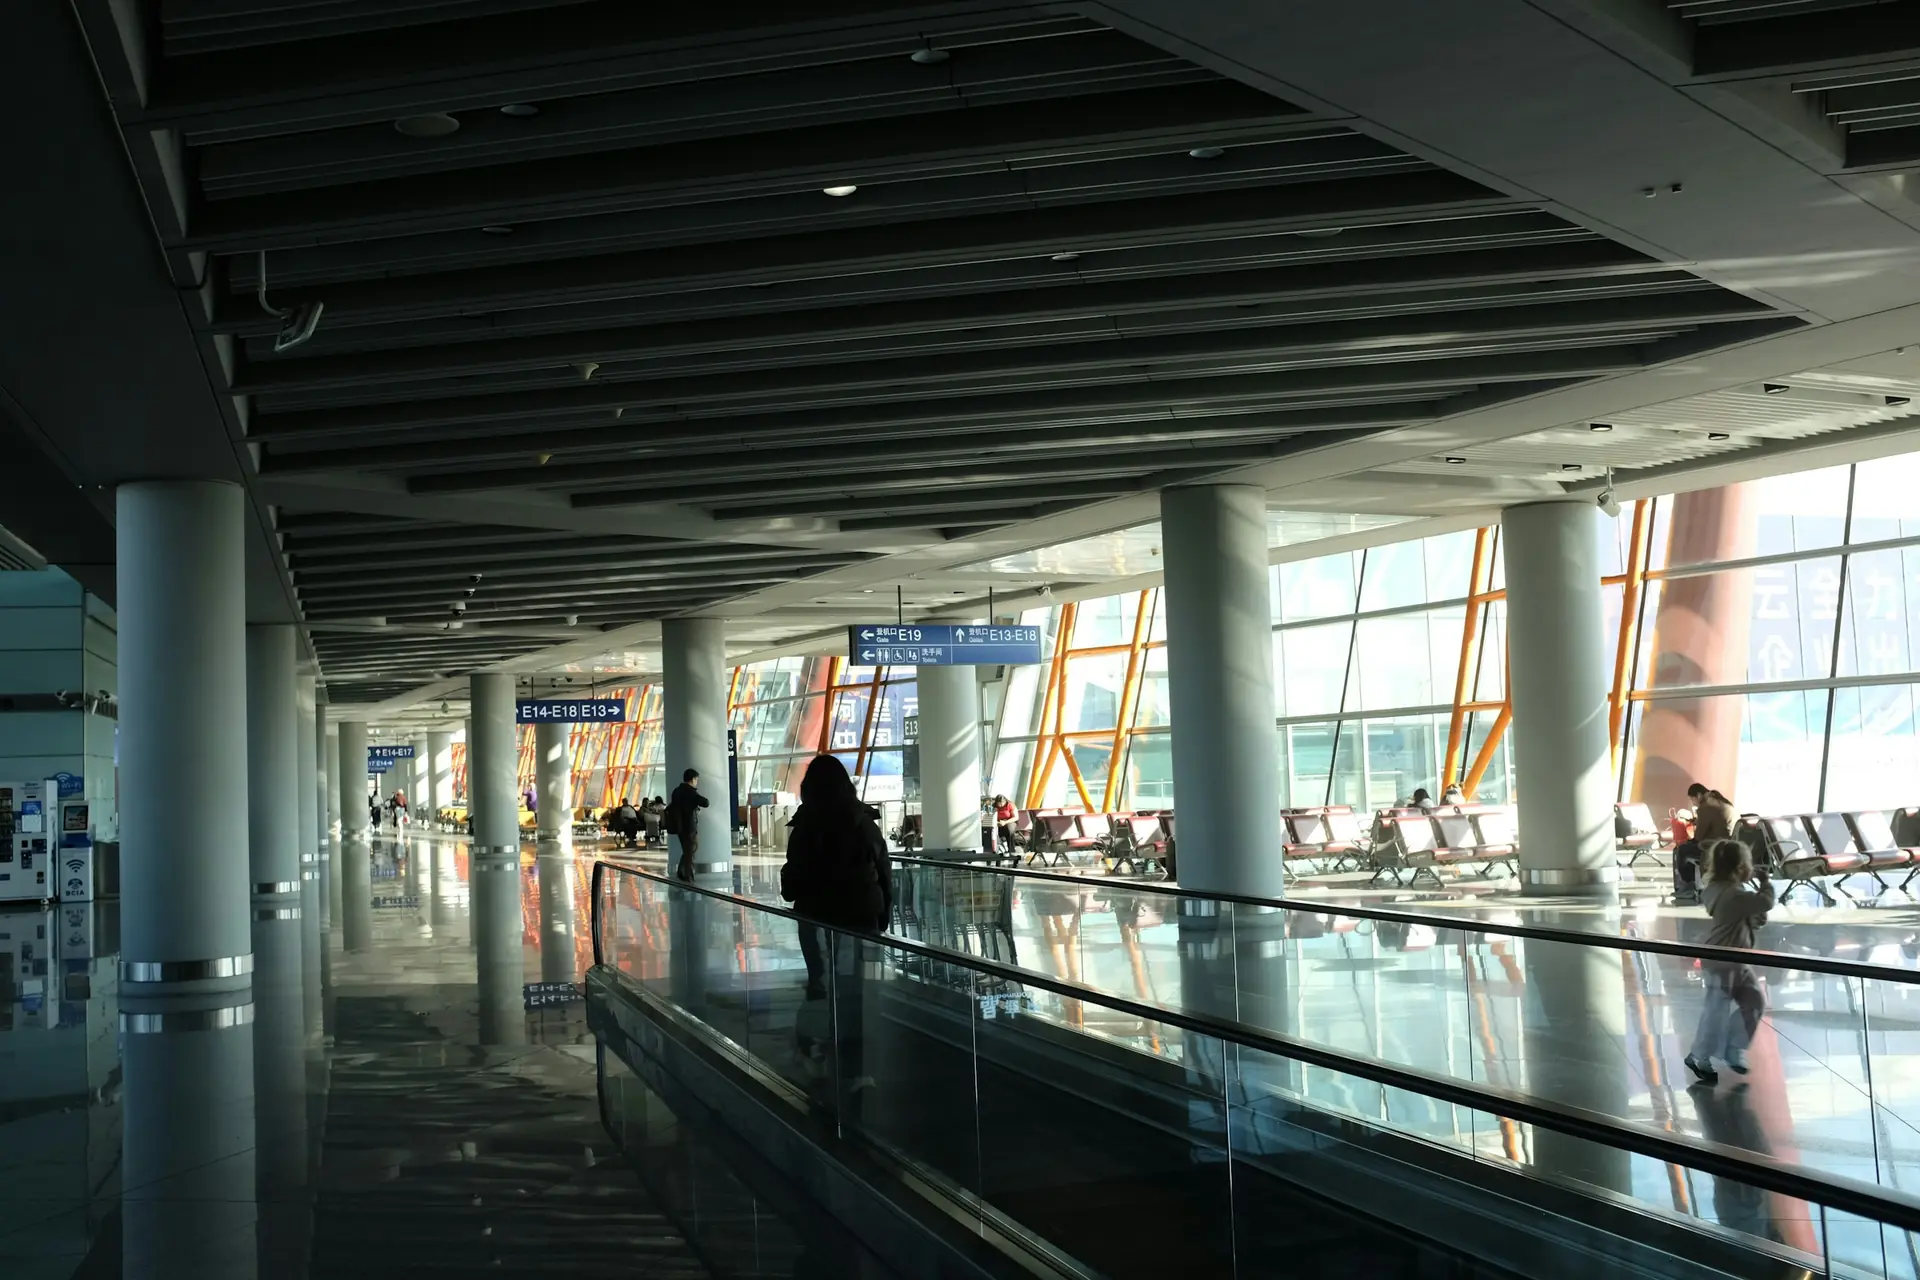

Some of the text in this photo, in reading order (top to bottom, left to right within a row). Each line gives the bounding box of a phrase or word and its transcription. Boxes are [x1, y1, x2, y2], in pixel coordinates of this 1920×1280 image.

[1754, 567, 1920, 621] 云全力
[876, 627, 897, 636] 登机口
[898, 629, 922, 641] E19
[968, 627, 989, 636] 登机口
[989, 629, 1037, 642] E13-E18
[522, 705, 578, 718] E14-E18
[581, 704, 607, 717] E13
[904, 721, 918, 735] E13
[382, 748, 412, 756] E14-E17
